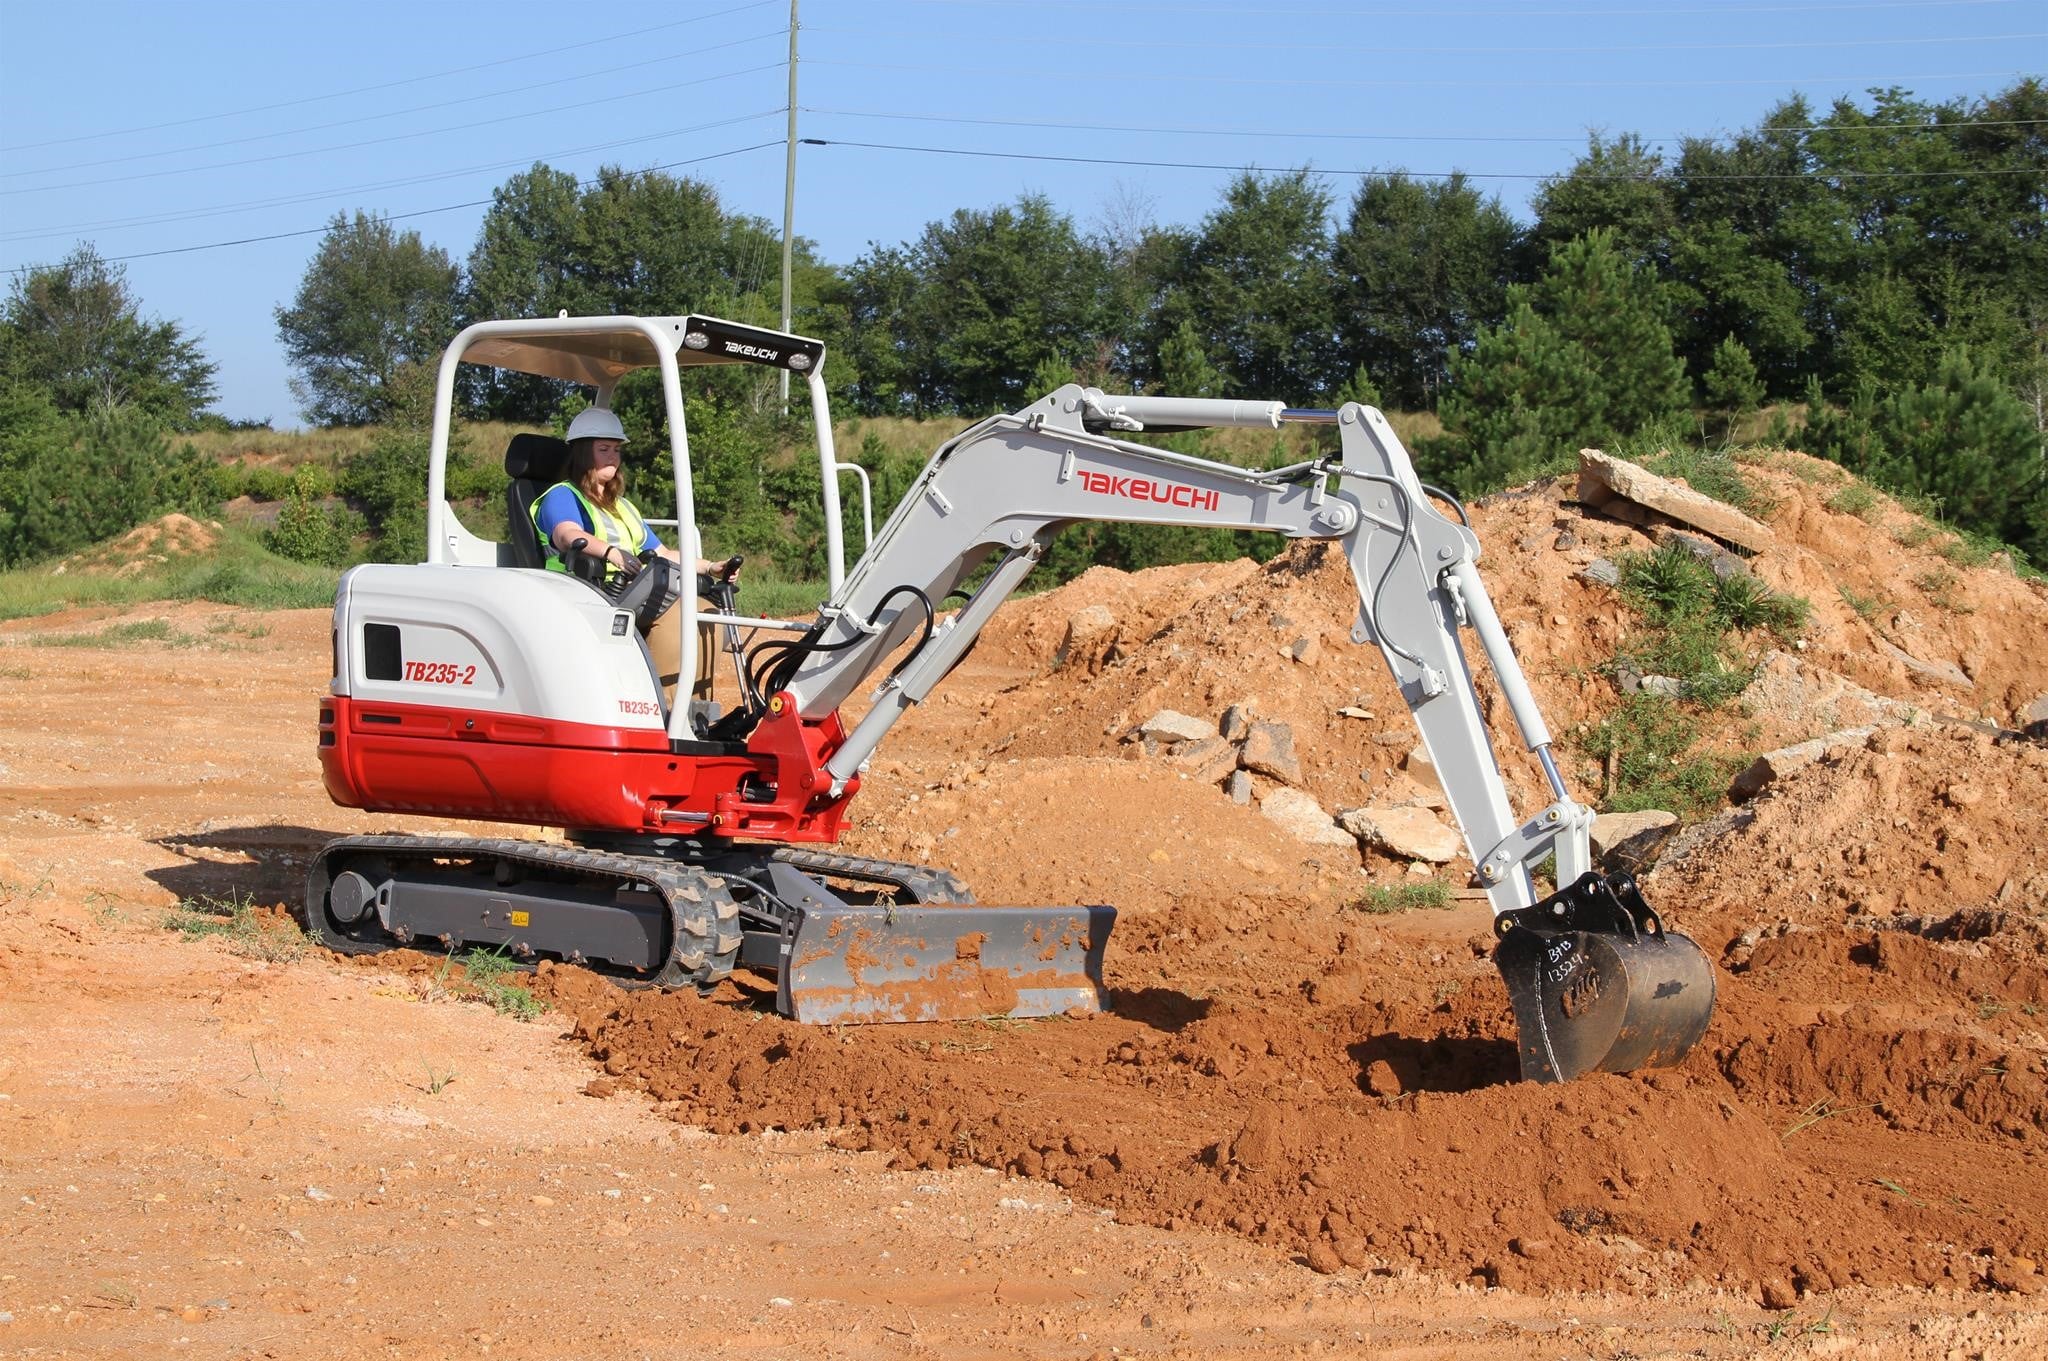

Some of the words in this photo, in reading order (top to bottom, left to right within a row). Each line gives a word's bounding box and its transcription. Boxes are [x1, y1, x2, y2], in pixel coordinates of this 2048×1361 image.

[405, 662, 477, 685] TB235-2
[619, 700, 660, 715] TB235-2
[1548, 953, 1583, 982] 13524
